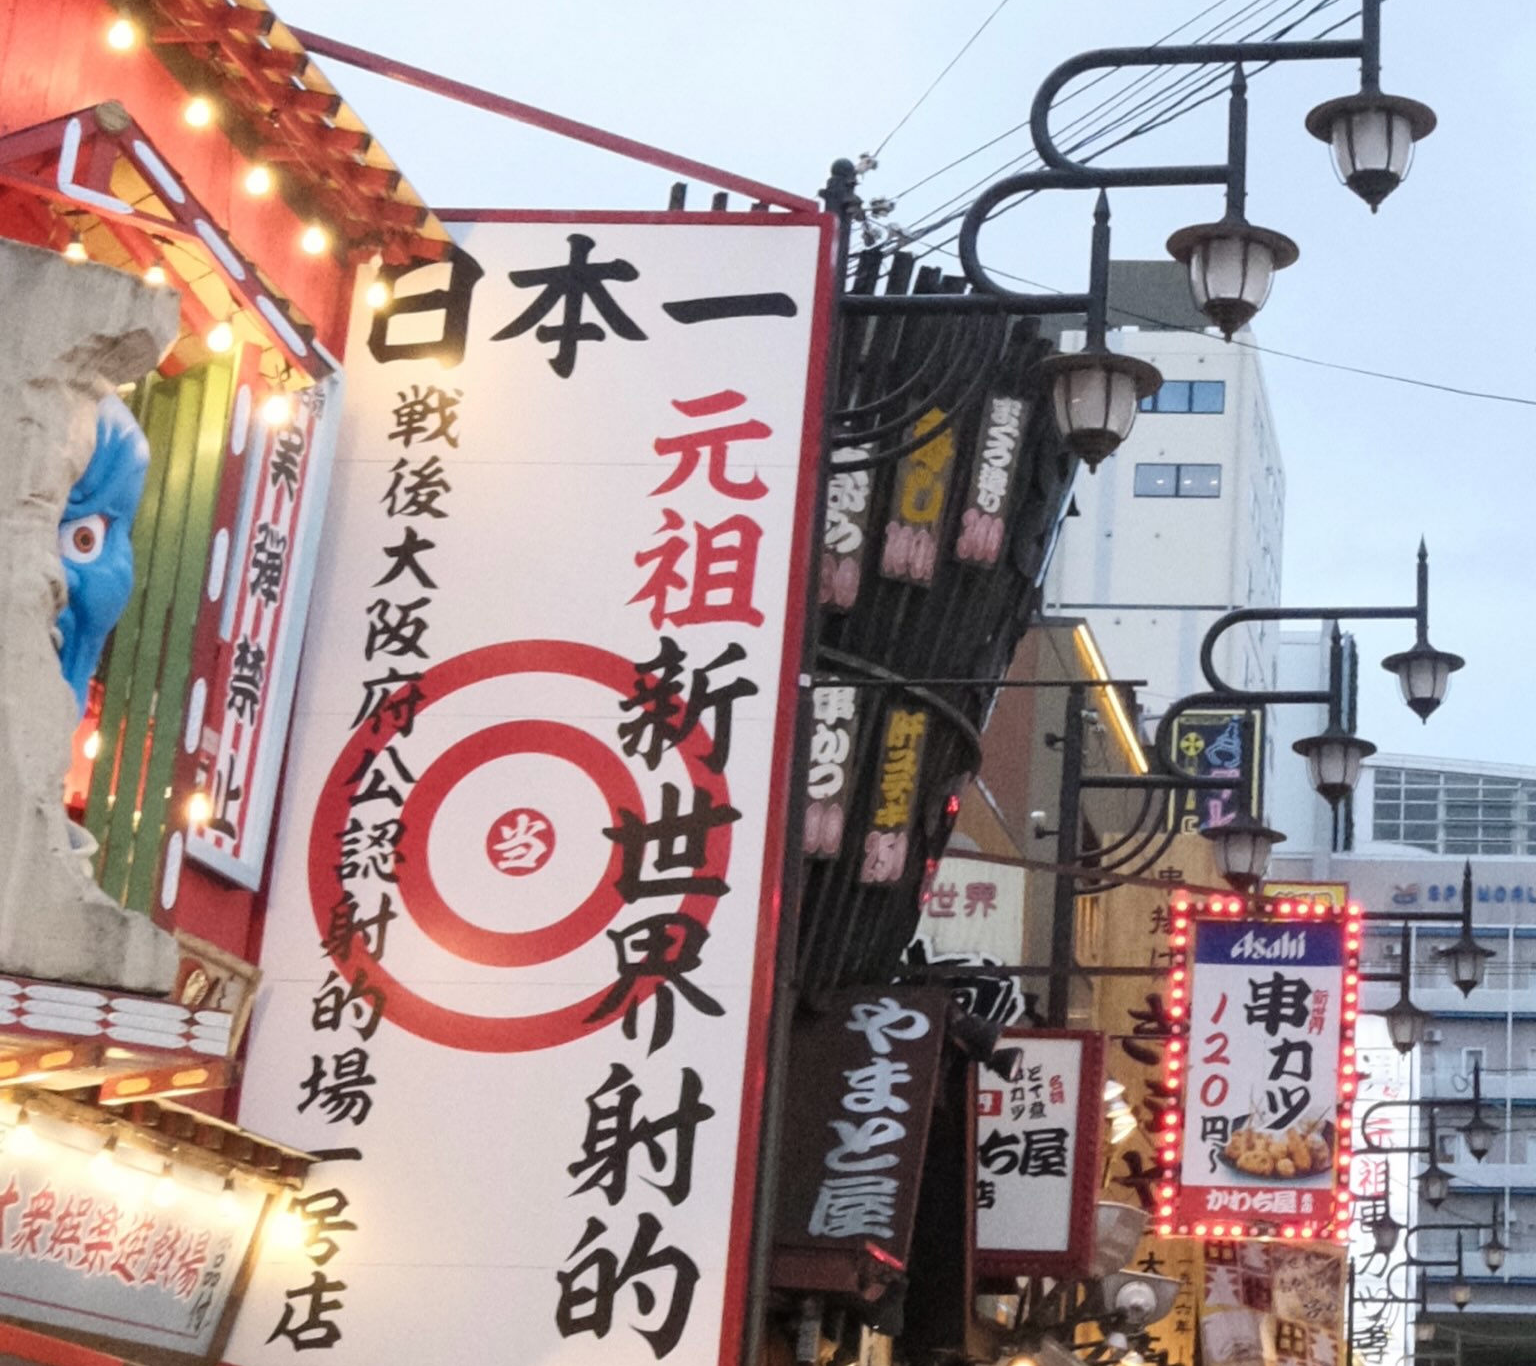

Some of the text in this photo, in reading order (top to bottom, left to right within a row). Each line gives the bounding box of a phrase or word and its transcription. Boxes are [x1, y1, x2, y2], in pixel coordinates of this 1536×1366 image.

[367, 233, 798, 379] 日本一
[265, 384, 463, 1351] 戦後大阪府公認射的場一号店
[555, 390, 773, 1360] 元祖新世界射的
[1231, 930, 1306, 960] Asahi
[808, 997, 929, 1239] やまと屋
[1244, 971, 1312, 1130] 串カツ
[1206, 1190, 1297, 1213] かわち屋
